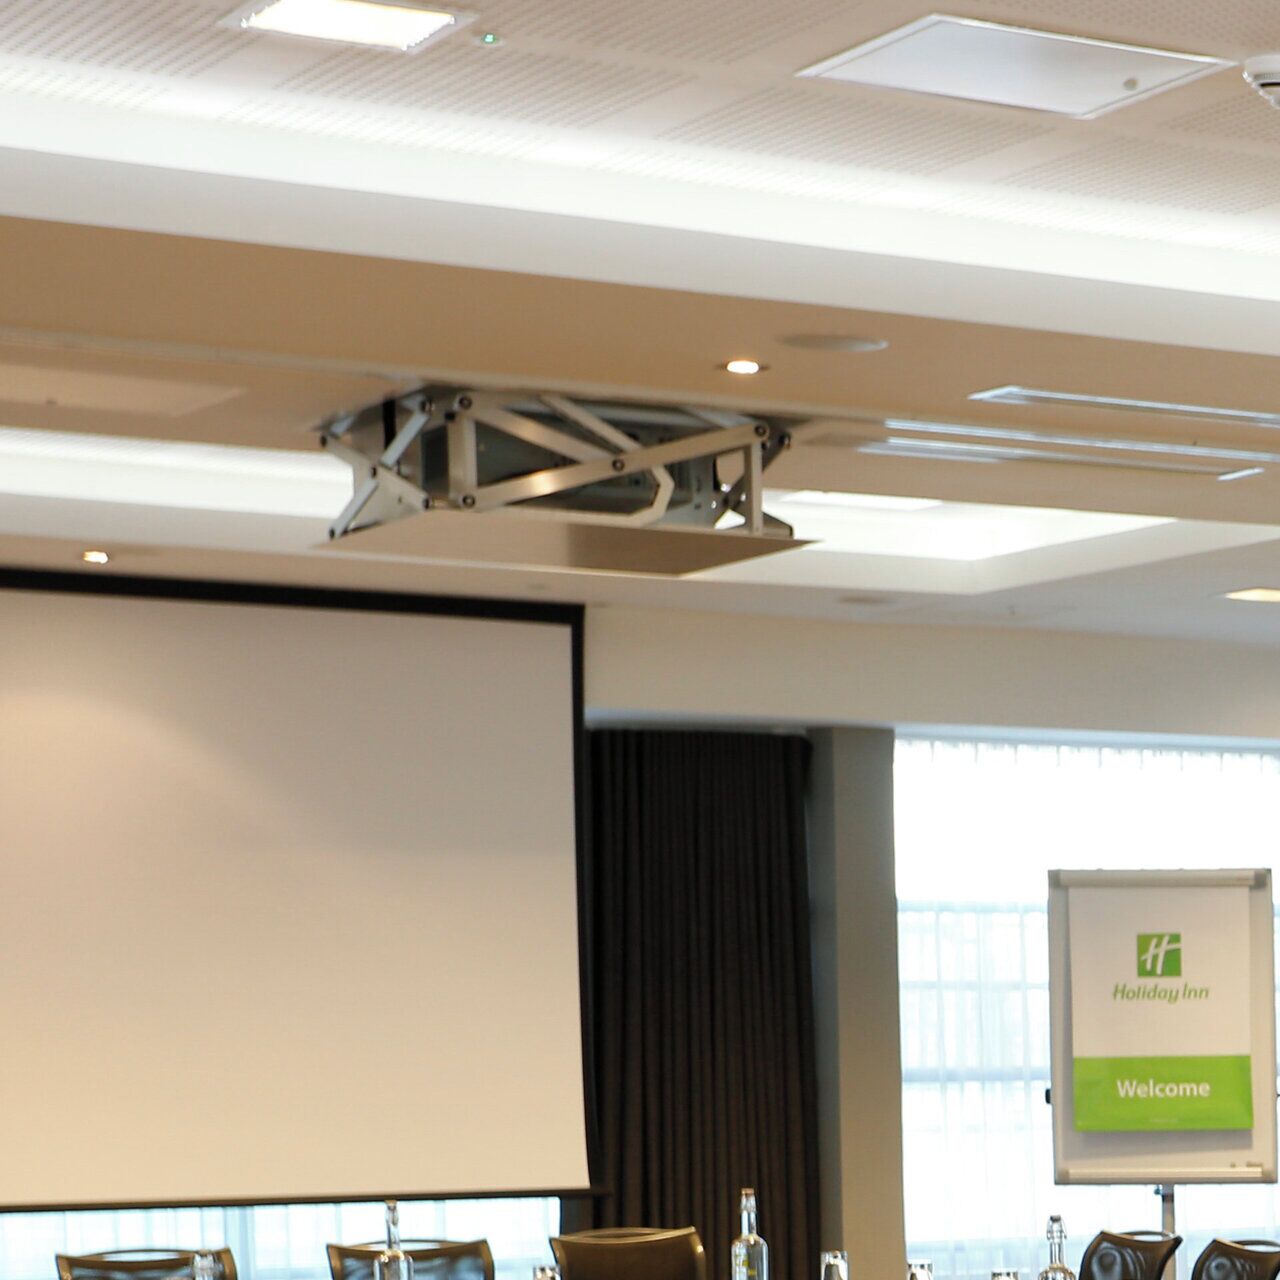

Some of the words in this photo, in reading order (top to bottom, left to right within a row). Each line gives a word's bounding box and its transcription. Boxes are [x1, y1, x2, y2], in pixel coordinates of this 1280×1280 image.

[1112, 982, 1179, 1004] Holiday
[1183, 981, 1209, 999] Inn
[1116, 1079, 1211, 1098] Welcome
